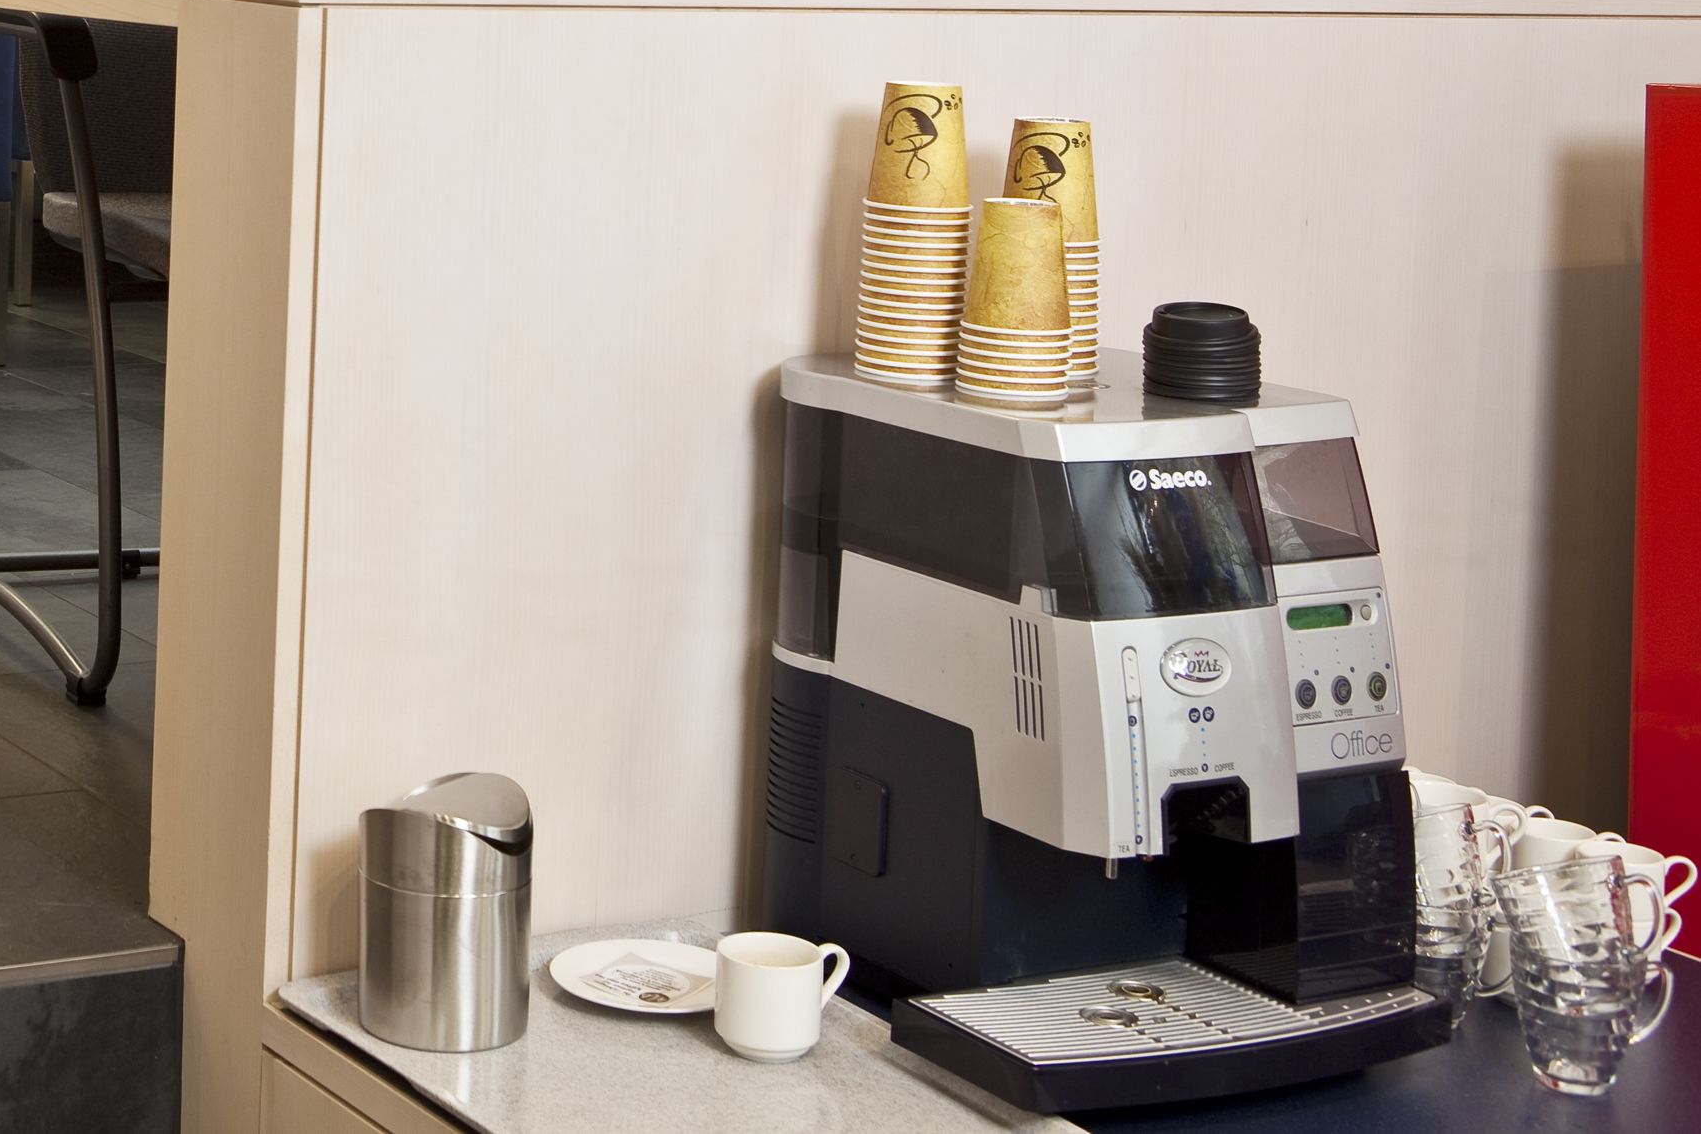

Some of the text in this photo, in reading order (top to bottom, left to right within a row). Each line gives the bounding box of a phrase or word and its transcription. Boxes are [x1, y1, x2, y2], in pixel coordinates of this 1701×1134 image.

[1334, 708, 1353, 718] COFFEE
[1374, 704, 1385, 713] TEA
[1295, 710, 1323, 722] ESPRESSO
[1330, 729, 1393, 760] Office
[1169, 766, 1199, 778] ESPRESSO
[1214, 762, 1235, 773] COFFEE
[1118, 845, 1130, 853] TEA
